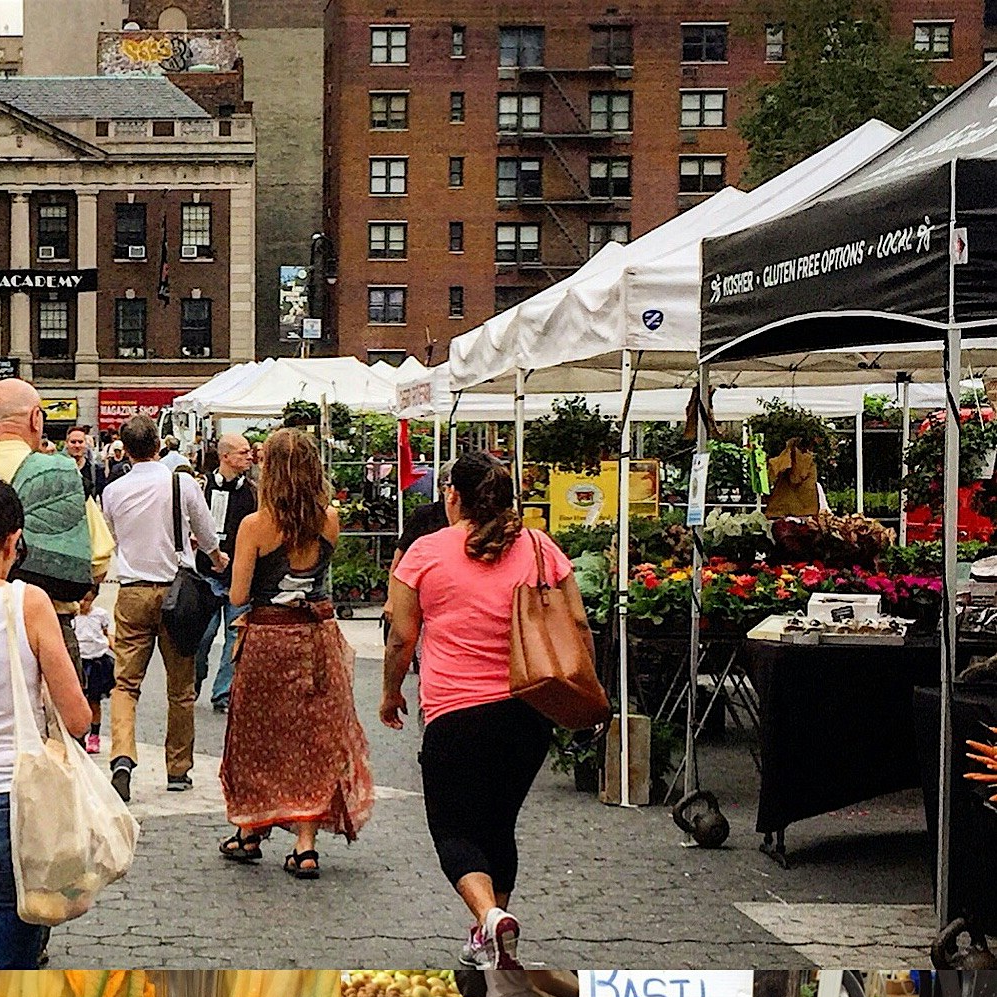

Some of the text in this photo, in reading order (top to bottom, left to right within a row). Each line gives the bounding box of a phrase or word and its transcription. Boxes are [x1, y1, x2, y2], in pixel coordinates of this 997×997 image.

[722, 226, 914, 297] KOSHER GLUTEN FREE OPTIONS LOCAL
[100, 406, 159, 415] MAGAZINE SHOP
